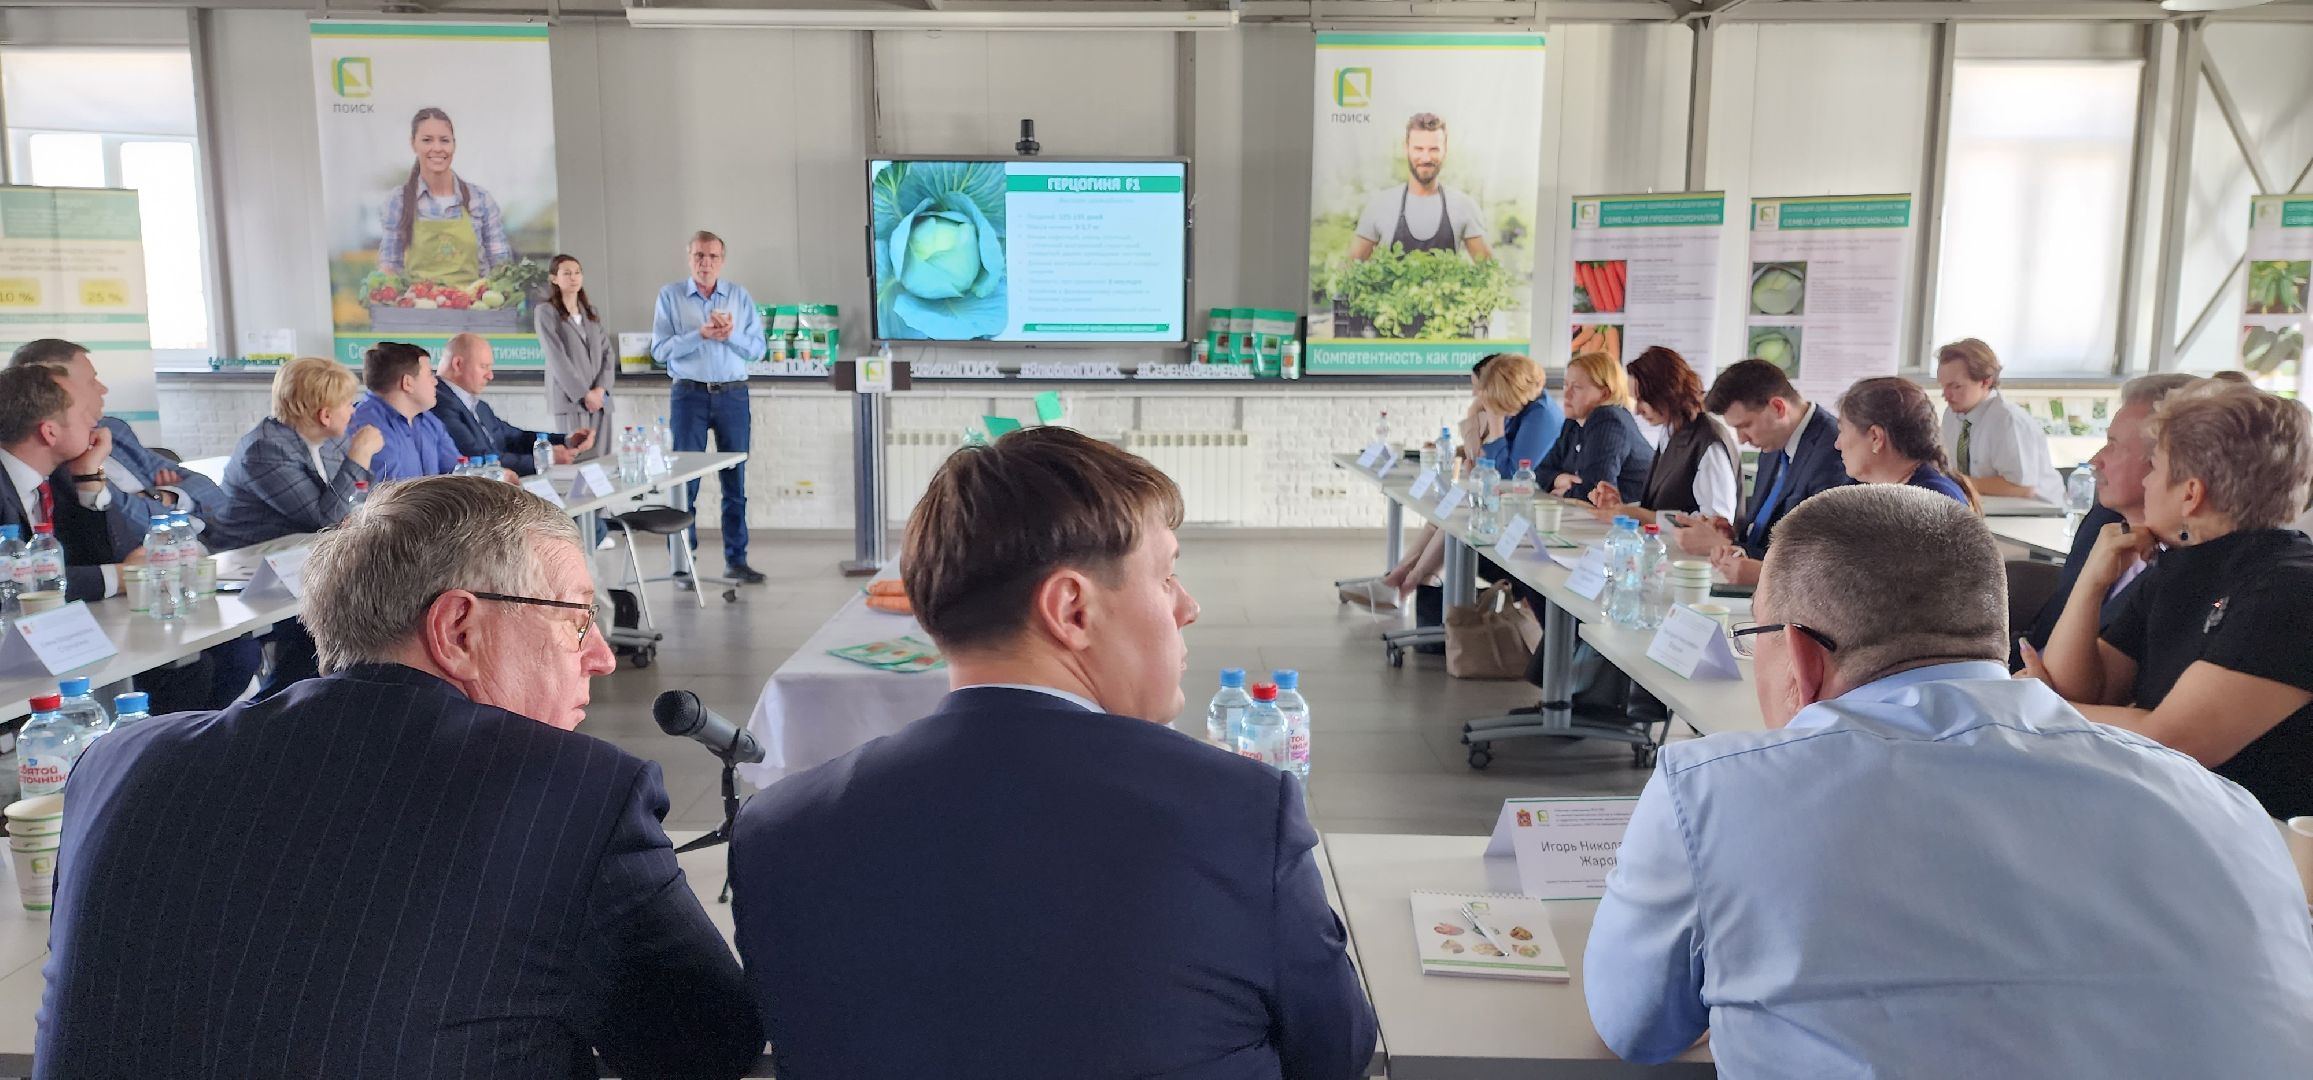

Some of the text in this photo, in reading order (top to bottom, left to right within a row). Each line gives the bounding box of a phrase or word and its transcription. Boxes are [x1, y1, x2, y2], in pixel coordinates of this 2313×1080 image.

[333, 104, 375, 114] ПОИСК
[1331, 113, 1371, 124] ПОИСК
[1047, 177, 1121, 192] ГЕРЦОГИНЯ
[493, 346, 543, 361] тижени
[1313, 348, 1488, 368] Компетентность как приз
[1541, 840, 1577, 853] Игорь
